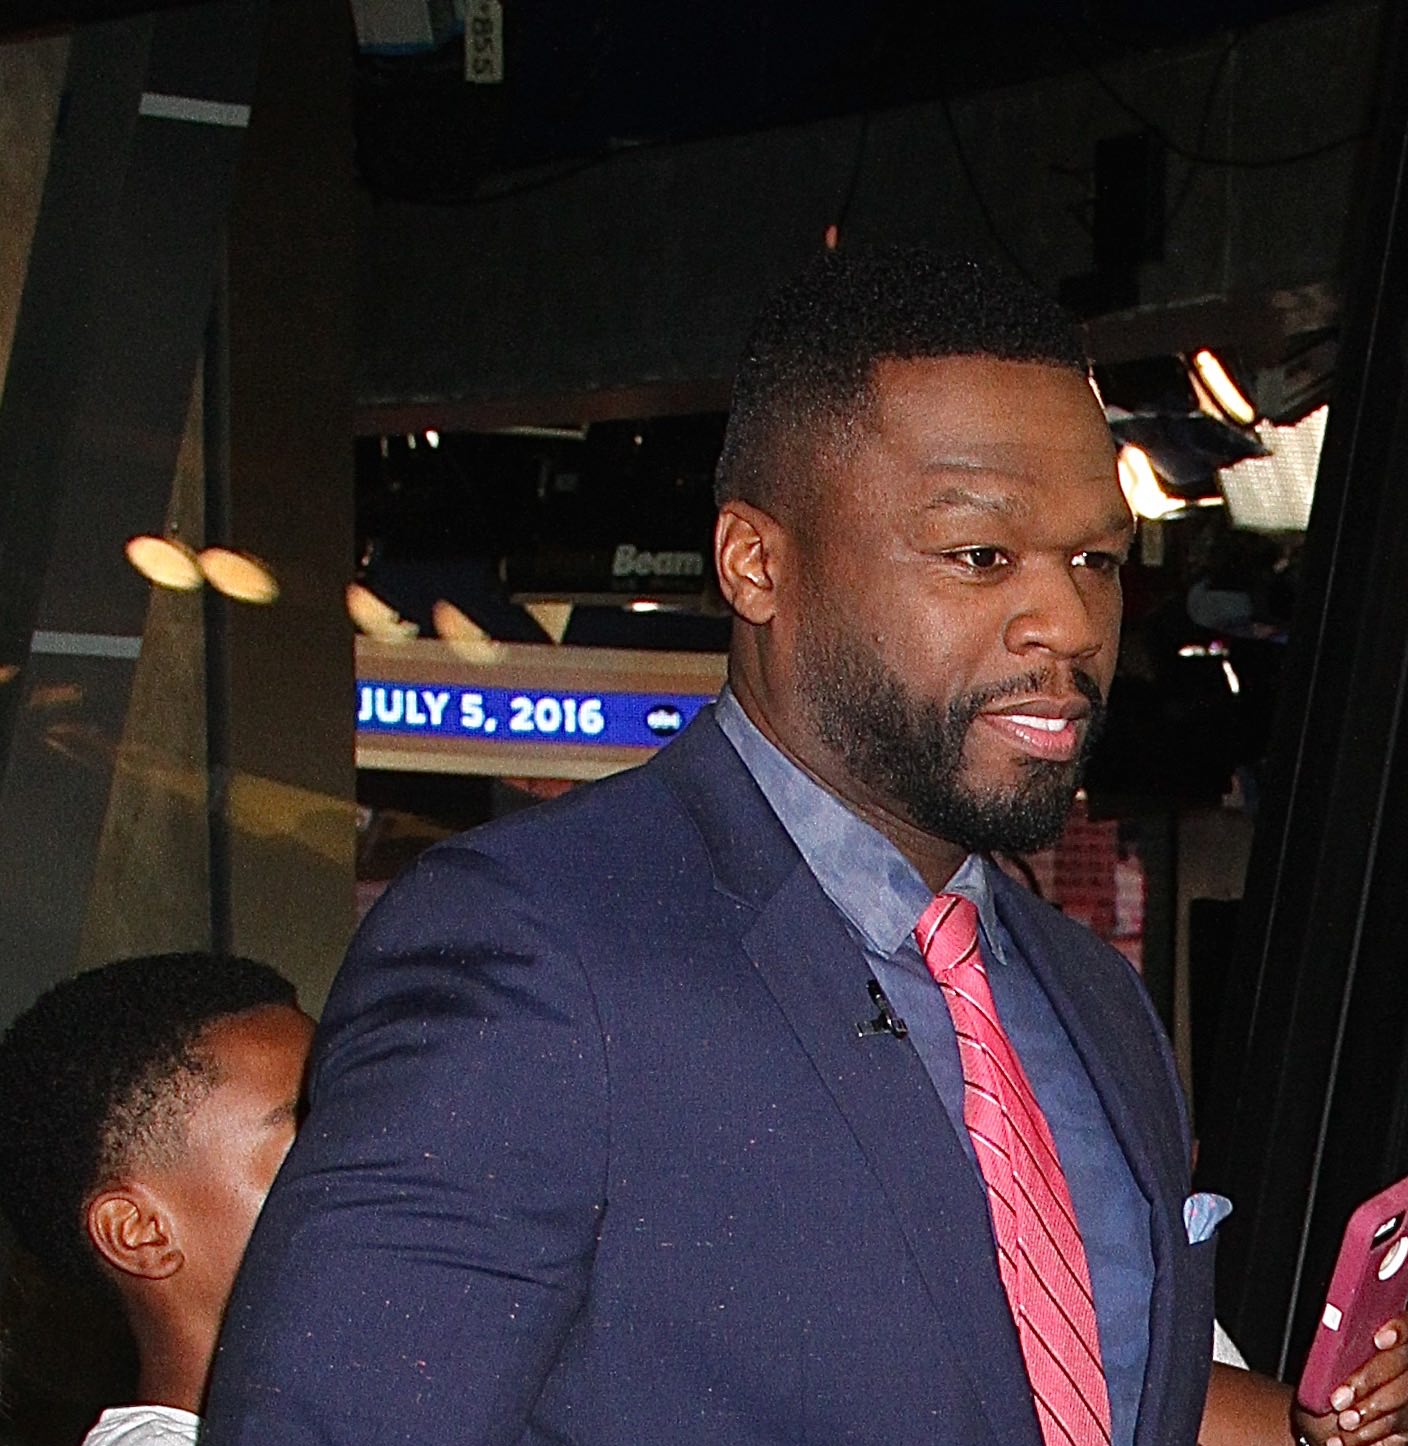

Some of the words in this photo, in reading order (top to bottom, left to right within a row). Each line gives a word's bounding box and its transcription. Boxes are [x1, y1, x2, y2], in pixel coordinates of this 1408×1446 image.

[358, 687, 449, 725] JULY
[460, 692, 497, 732] 5,
[509, 696, 604, 734] 2016
